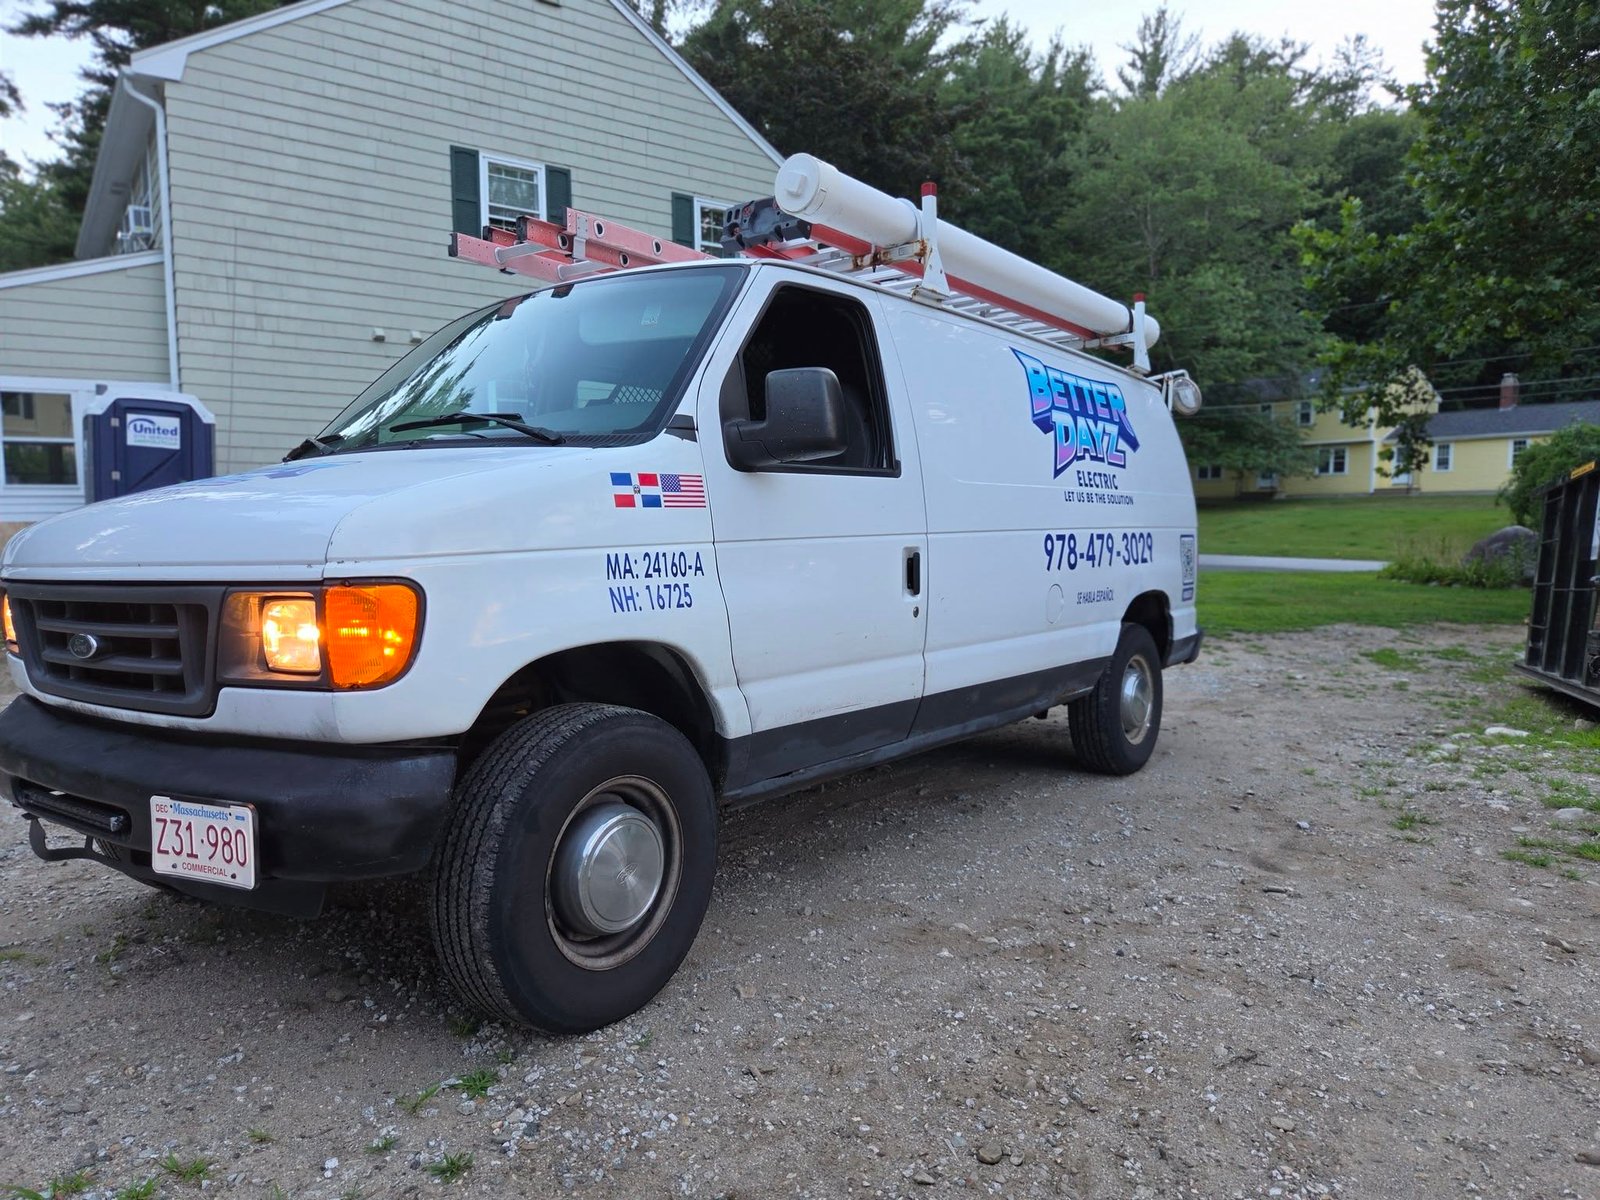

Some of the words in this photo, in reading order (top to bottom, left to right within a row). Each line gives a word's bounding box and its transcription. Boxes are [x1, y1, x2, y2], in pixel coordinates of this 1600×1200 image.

[1009, 346, 1140, 450] BETTER
[133, 423, 178, 436] United
[1051, 409, 1126, 480] DAYZ
[1076, 470, 1118, 490] ELECTRIC
[1064, 491, 1075, 502] LET
[1076, 492, 1085, 503] US
[1086, 492, 1094, 503] BE
[1095, 493, 1106, 504] THE
[1107, 494, 1134, 505] SOLUTION
[1044, 532, 1153, 571] 978-479-3029
[606, 553, 639, 580] MA:
[643, 551, 705, 579] 24160-A
[608, 586, 642, 613] NH:
[645, 583, 693, 610] 16725
[155, 803, 169, 814] DEC
[172, 803, 229, 821] Massachusetts
[182, 861, 228, 877] COMMERCIAL
